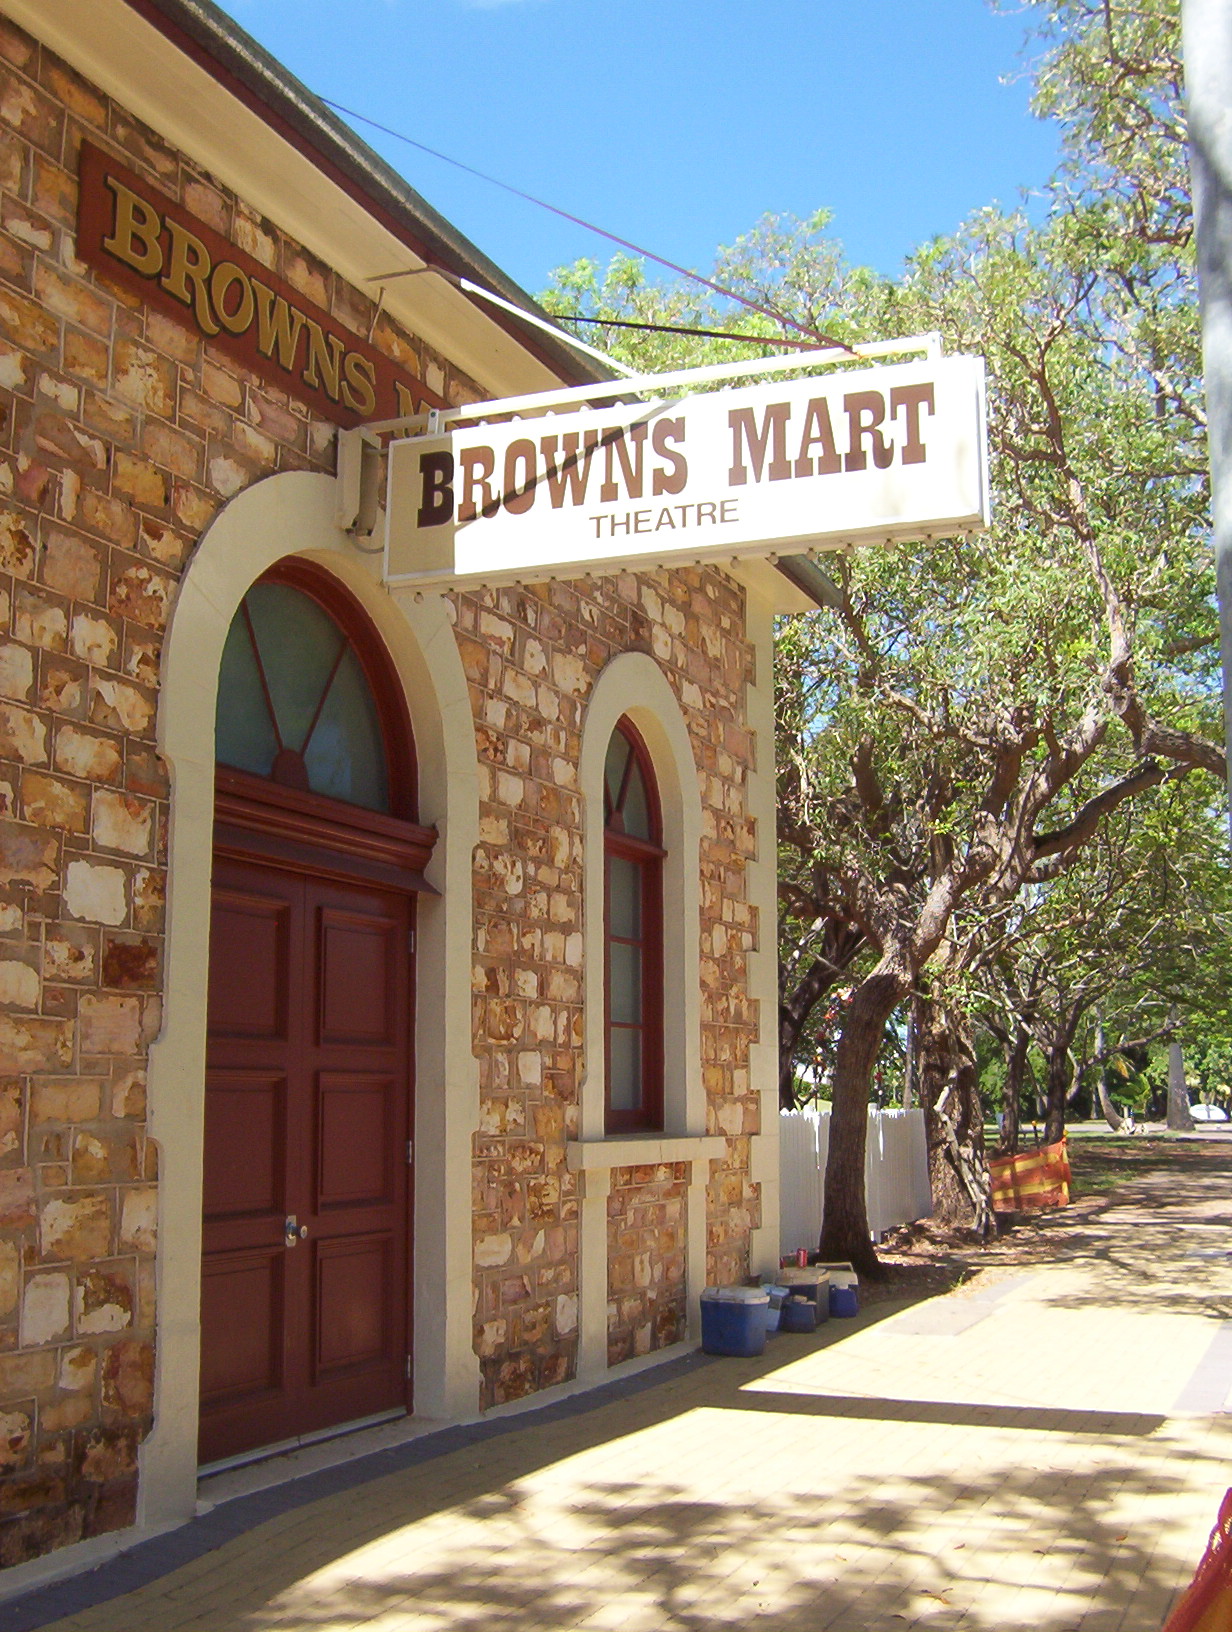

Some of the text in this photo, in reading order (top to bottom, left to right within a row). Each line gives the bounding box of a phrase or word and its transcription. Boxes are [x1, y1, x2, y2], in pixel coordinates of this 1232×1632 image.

[103, 174, 377, 417] BROWNS
[417, 382, 935, 528] BROWNS MART
[589, 499, 739, 539] THEATRE
